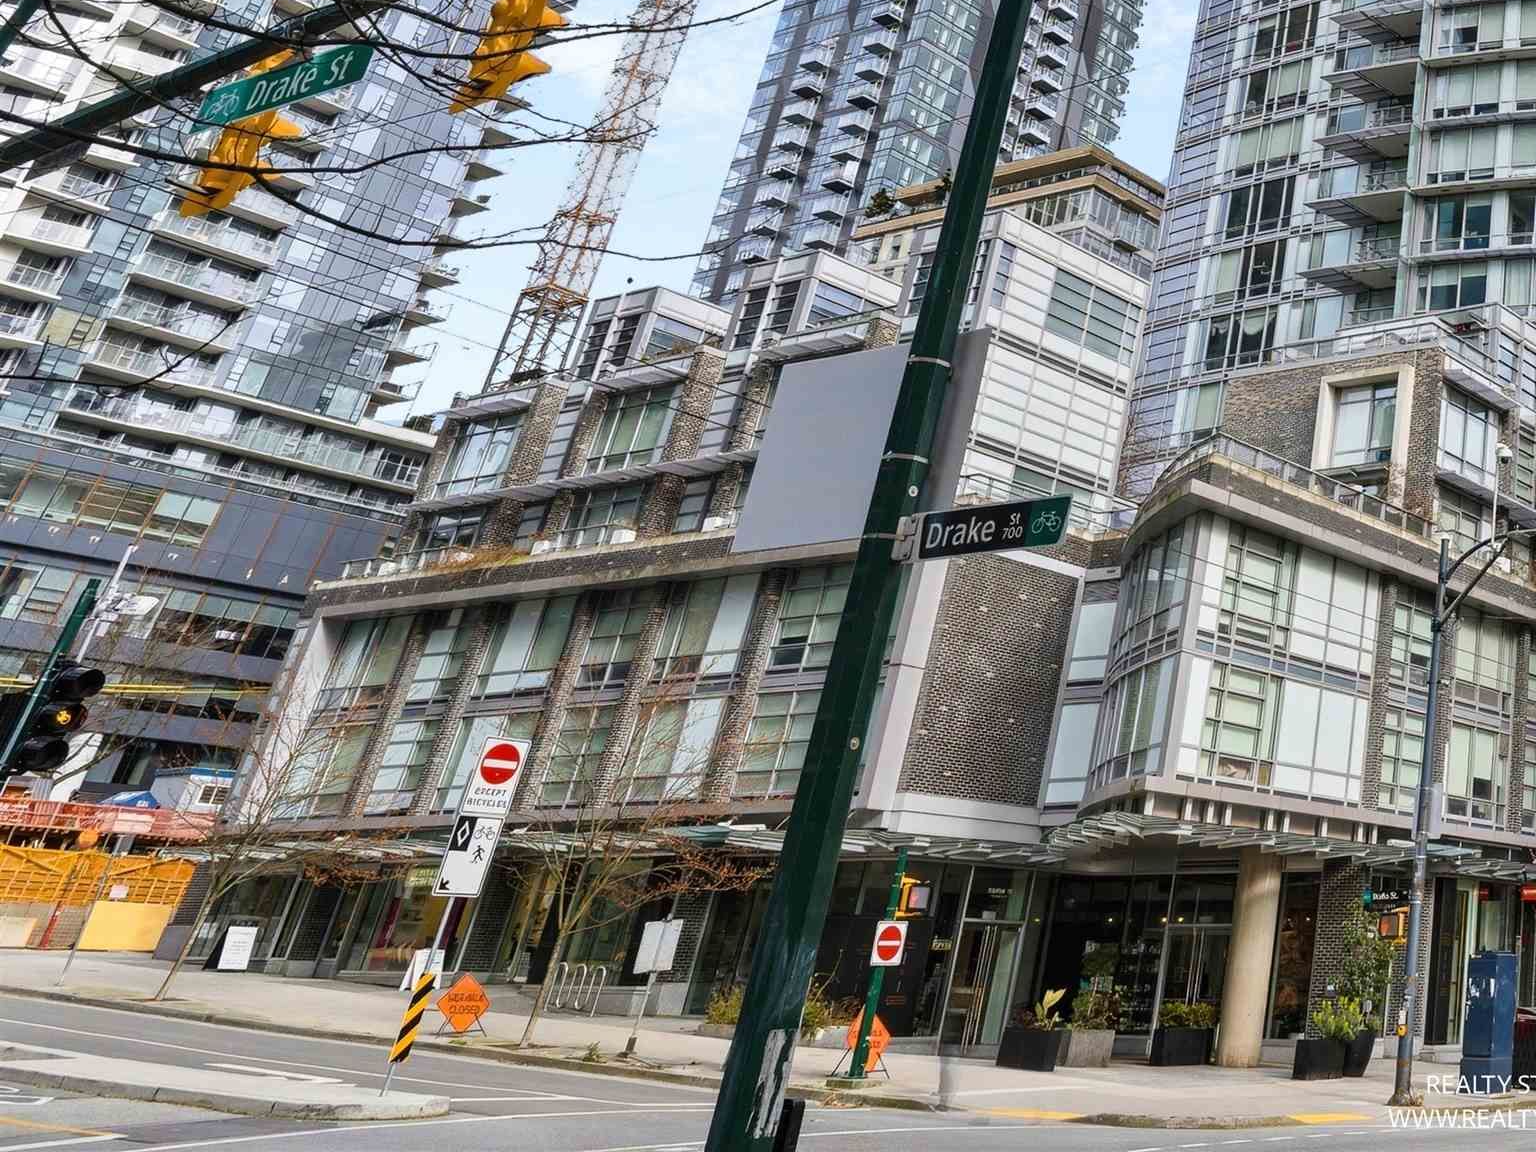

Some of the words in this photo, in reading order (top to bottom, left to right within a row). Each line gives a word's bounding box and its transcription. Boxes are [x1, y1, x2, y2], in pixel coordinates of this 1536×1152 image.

[246, 65, 319, 111] Drake
[323, 50, 355, 86] St
[925, 516, 996, 549] Drake
[1009, 513, 1021, 526] St
[1002, 526, 1024, 540] 700
